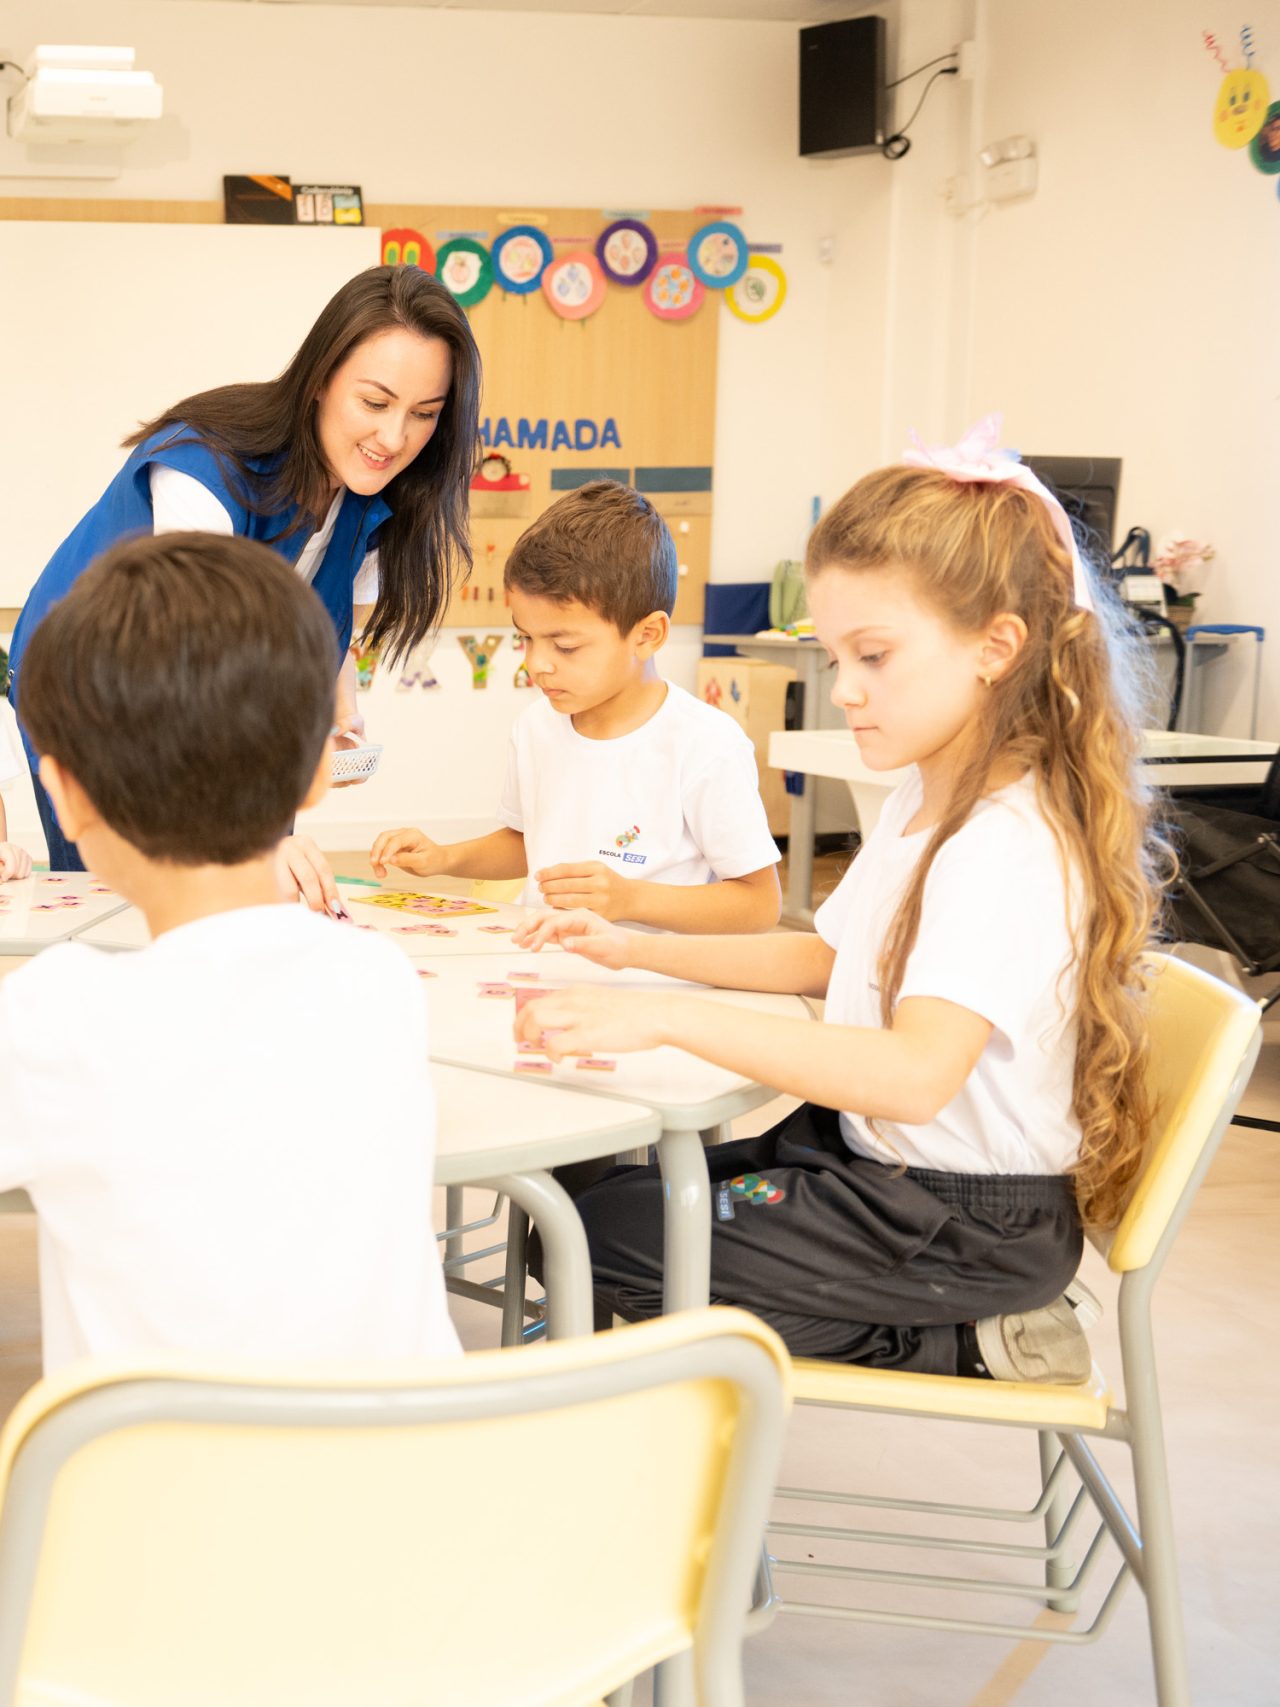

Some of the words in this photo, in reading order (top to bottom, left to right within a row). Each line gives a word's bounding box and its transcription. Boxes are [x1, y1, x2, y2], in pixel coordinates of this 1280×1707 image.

[598, 850, 622, 858] ESCOLA
[624, 854, 646, 864] SESI
[720, 1190, 730, 1218] SESI
